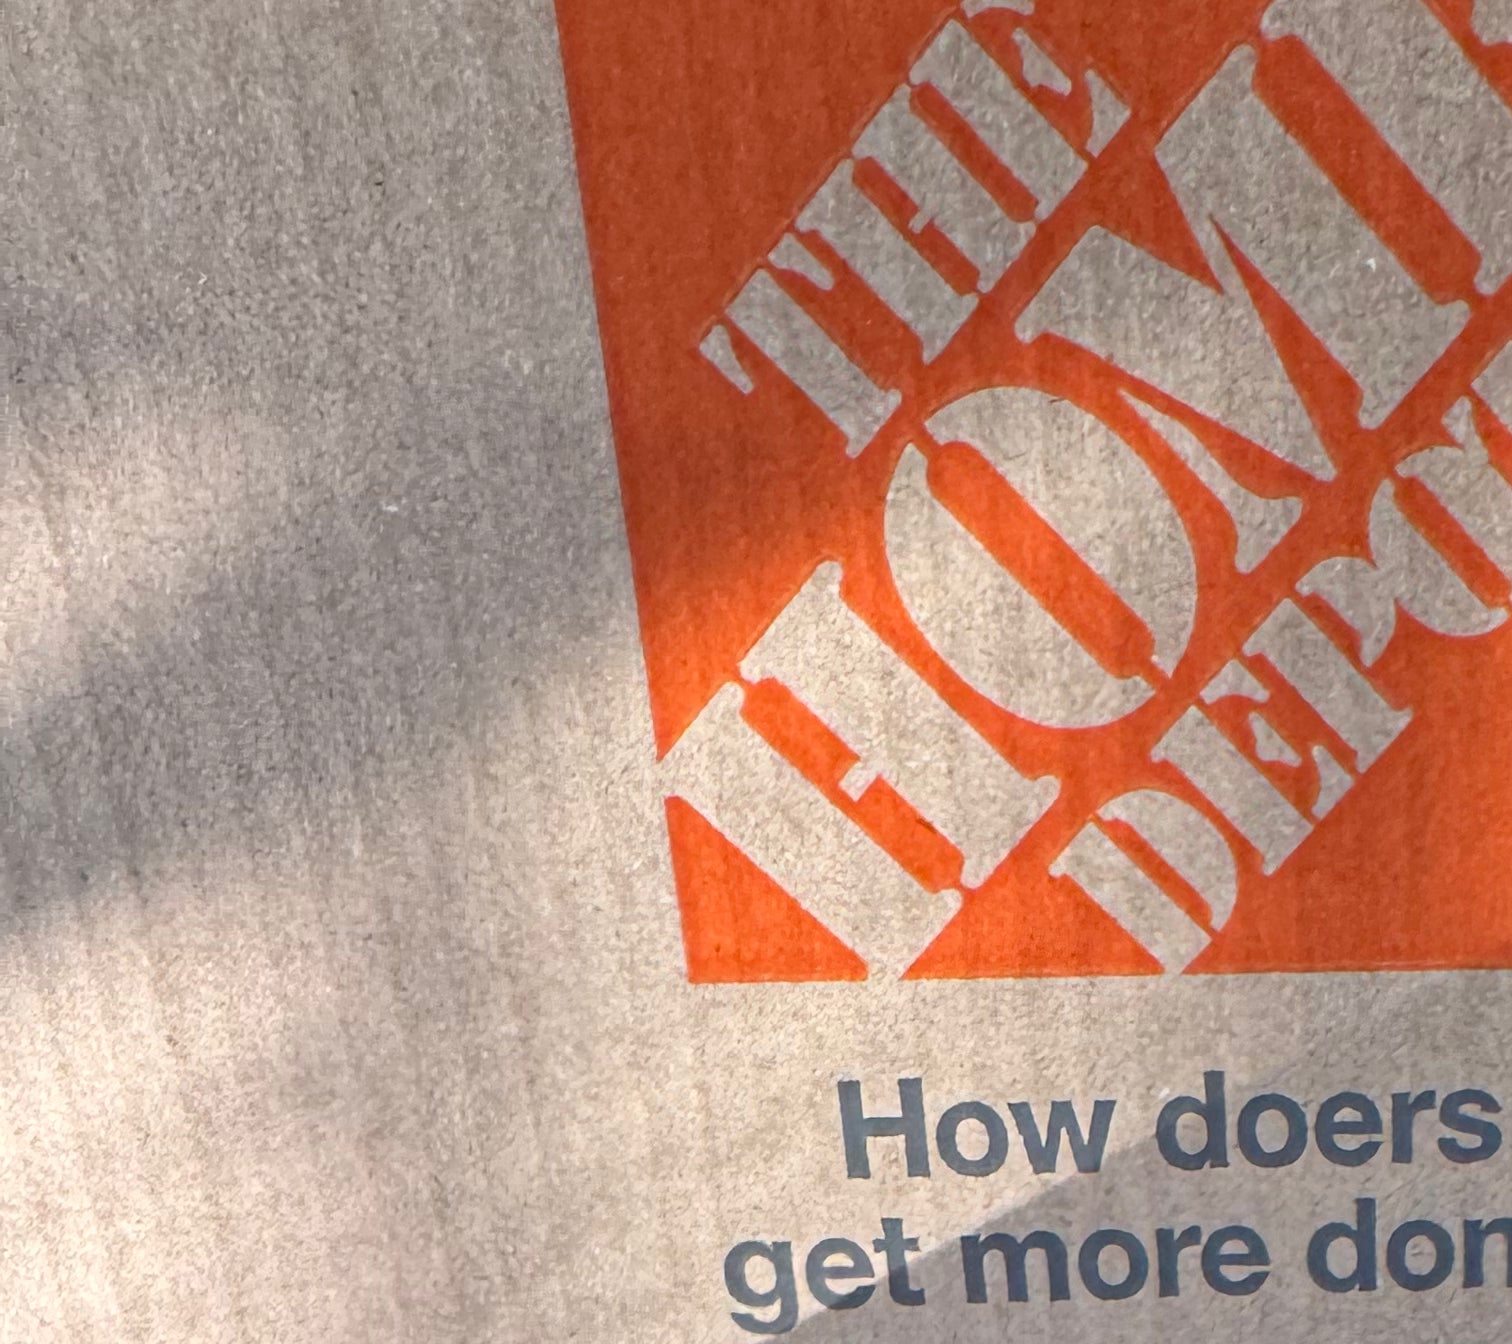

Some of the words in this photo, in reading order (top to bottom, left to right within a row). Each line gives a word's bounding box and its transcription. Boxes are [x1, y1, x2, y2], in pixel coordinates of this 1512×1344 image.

[698, 0, 1131, 458] THE
[836, 1076, 1116, 1180] How
[1154, 1070, 1504, 1173] doers
[723, 1216, 926, 1335] get
[961, 1223, 1271, 1306] more
